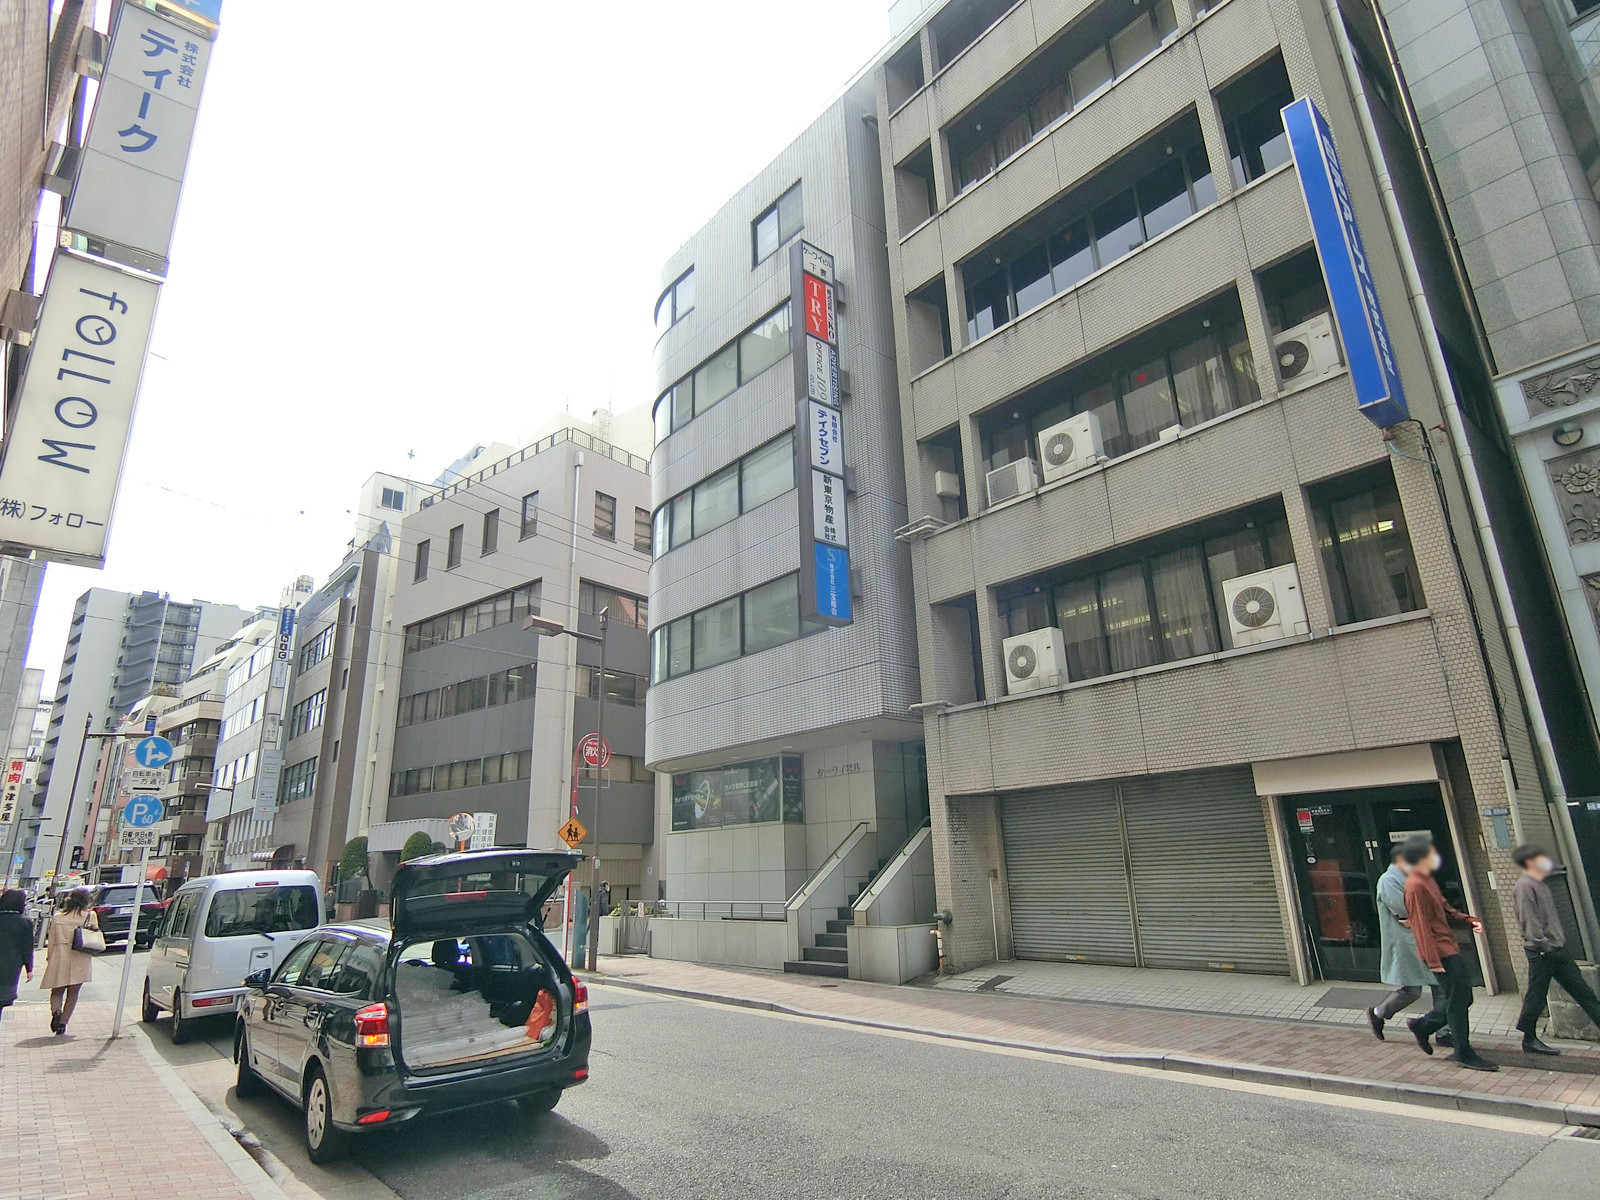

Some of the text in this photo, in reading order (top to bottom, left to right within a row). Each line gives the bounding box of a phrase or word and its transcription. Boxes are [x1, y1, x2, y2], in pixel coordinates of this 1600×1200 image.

[177, 41, 200, 89] 株式会社
[808, 279, 822, 333] TRY
[38, 287, 128, 474] follow
[815, 341, 828, 401] OFFICE 109
[830, 349, 839, 407] ADVERTISING
[823, 474, 835, 525] 新東京物産
[7, 761, 24, 783] 精肉
[131, 778, 166, 786] 一方通行
[131, 803, 149, 824] P
[142, 814, 153, 824] 60
